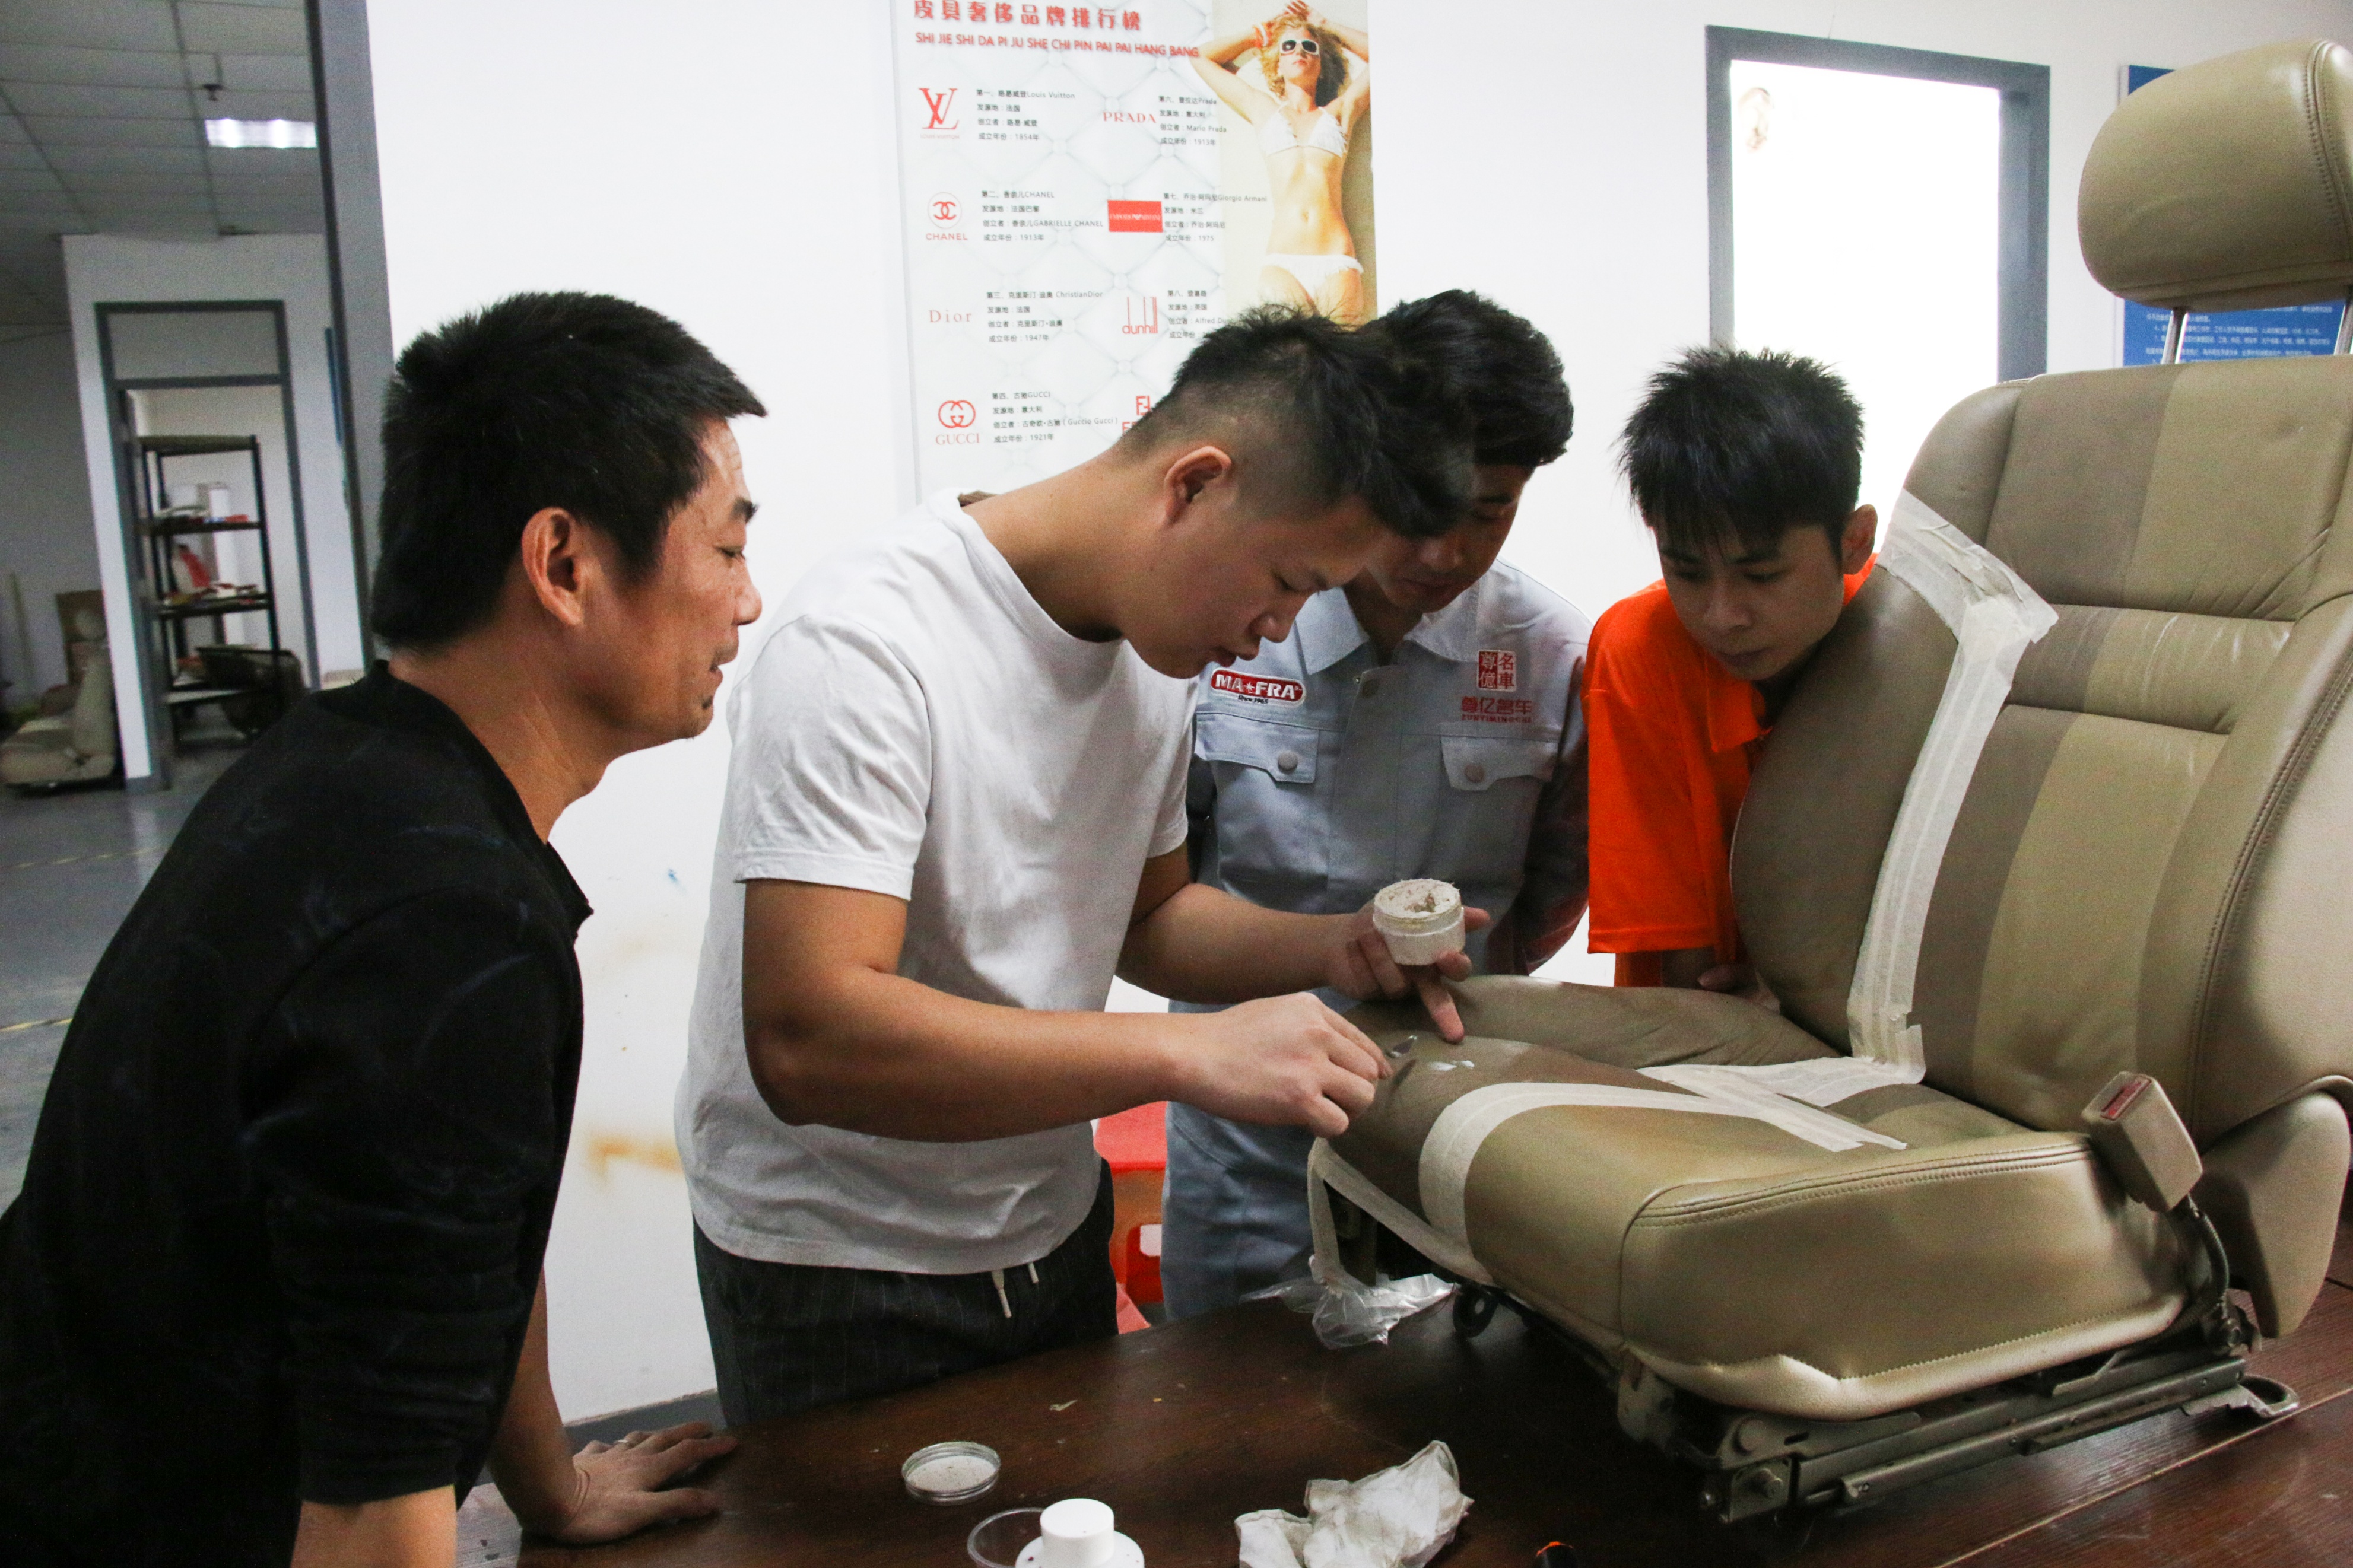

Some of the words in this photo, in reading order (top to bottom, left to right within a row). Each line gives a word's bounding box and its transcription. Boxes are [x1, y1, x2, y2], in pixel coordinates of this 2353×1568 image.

[916, 32, 934, 44] SHI
[938, 33, 952, 44] JIE
[956, 34, 974, 45] SHI
[978, 35, 994, 46] DA
[998, 36, 1007, 47] PI
[1011, 37, 1023, 47] JU
[1027, 37, 1047, 49] SHE
[1051, 39, 1070, 50] CHI
[1074, 40, 1092, 50] PIN
[1096, 42, 1112, 52] PAI
[1116, 43, 1131, 53] PAI
[1135, 44, 1166, 55] HANG
[1170, 46, 1199, 58] BANG
[1103, 112, 1157, 123] PRADA
[1208, 125, 1227, 133] Prada
[926, 233, 968, 241] CHANEL
[929, 310, 973, 323] Dior
[1122, 296, 1158, 335] dunhill
[935, 433, 980, 445] GUCCI
